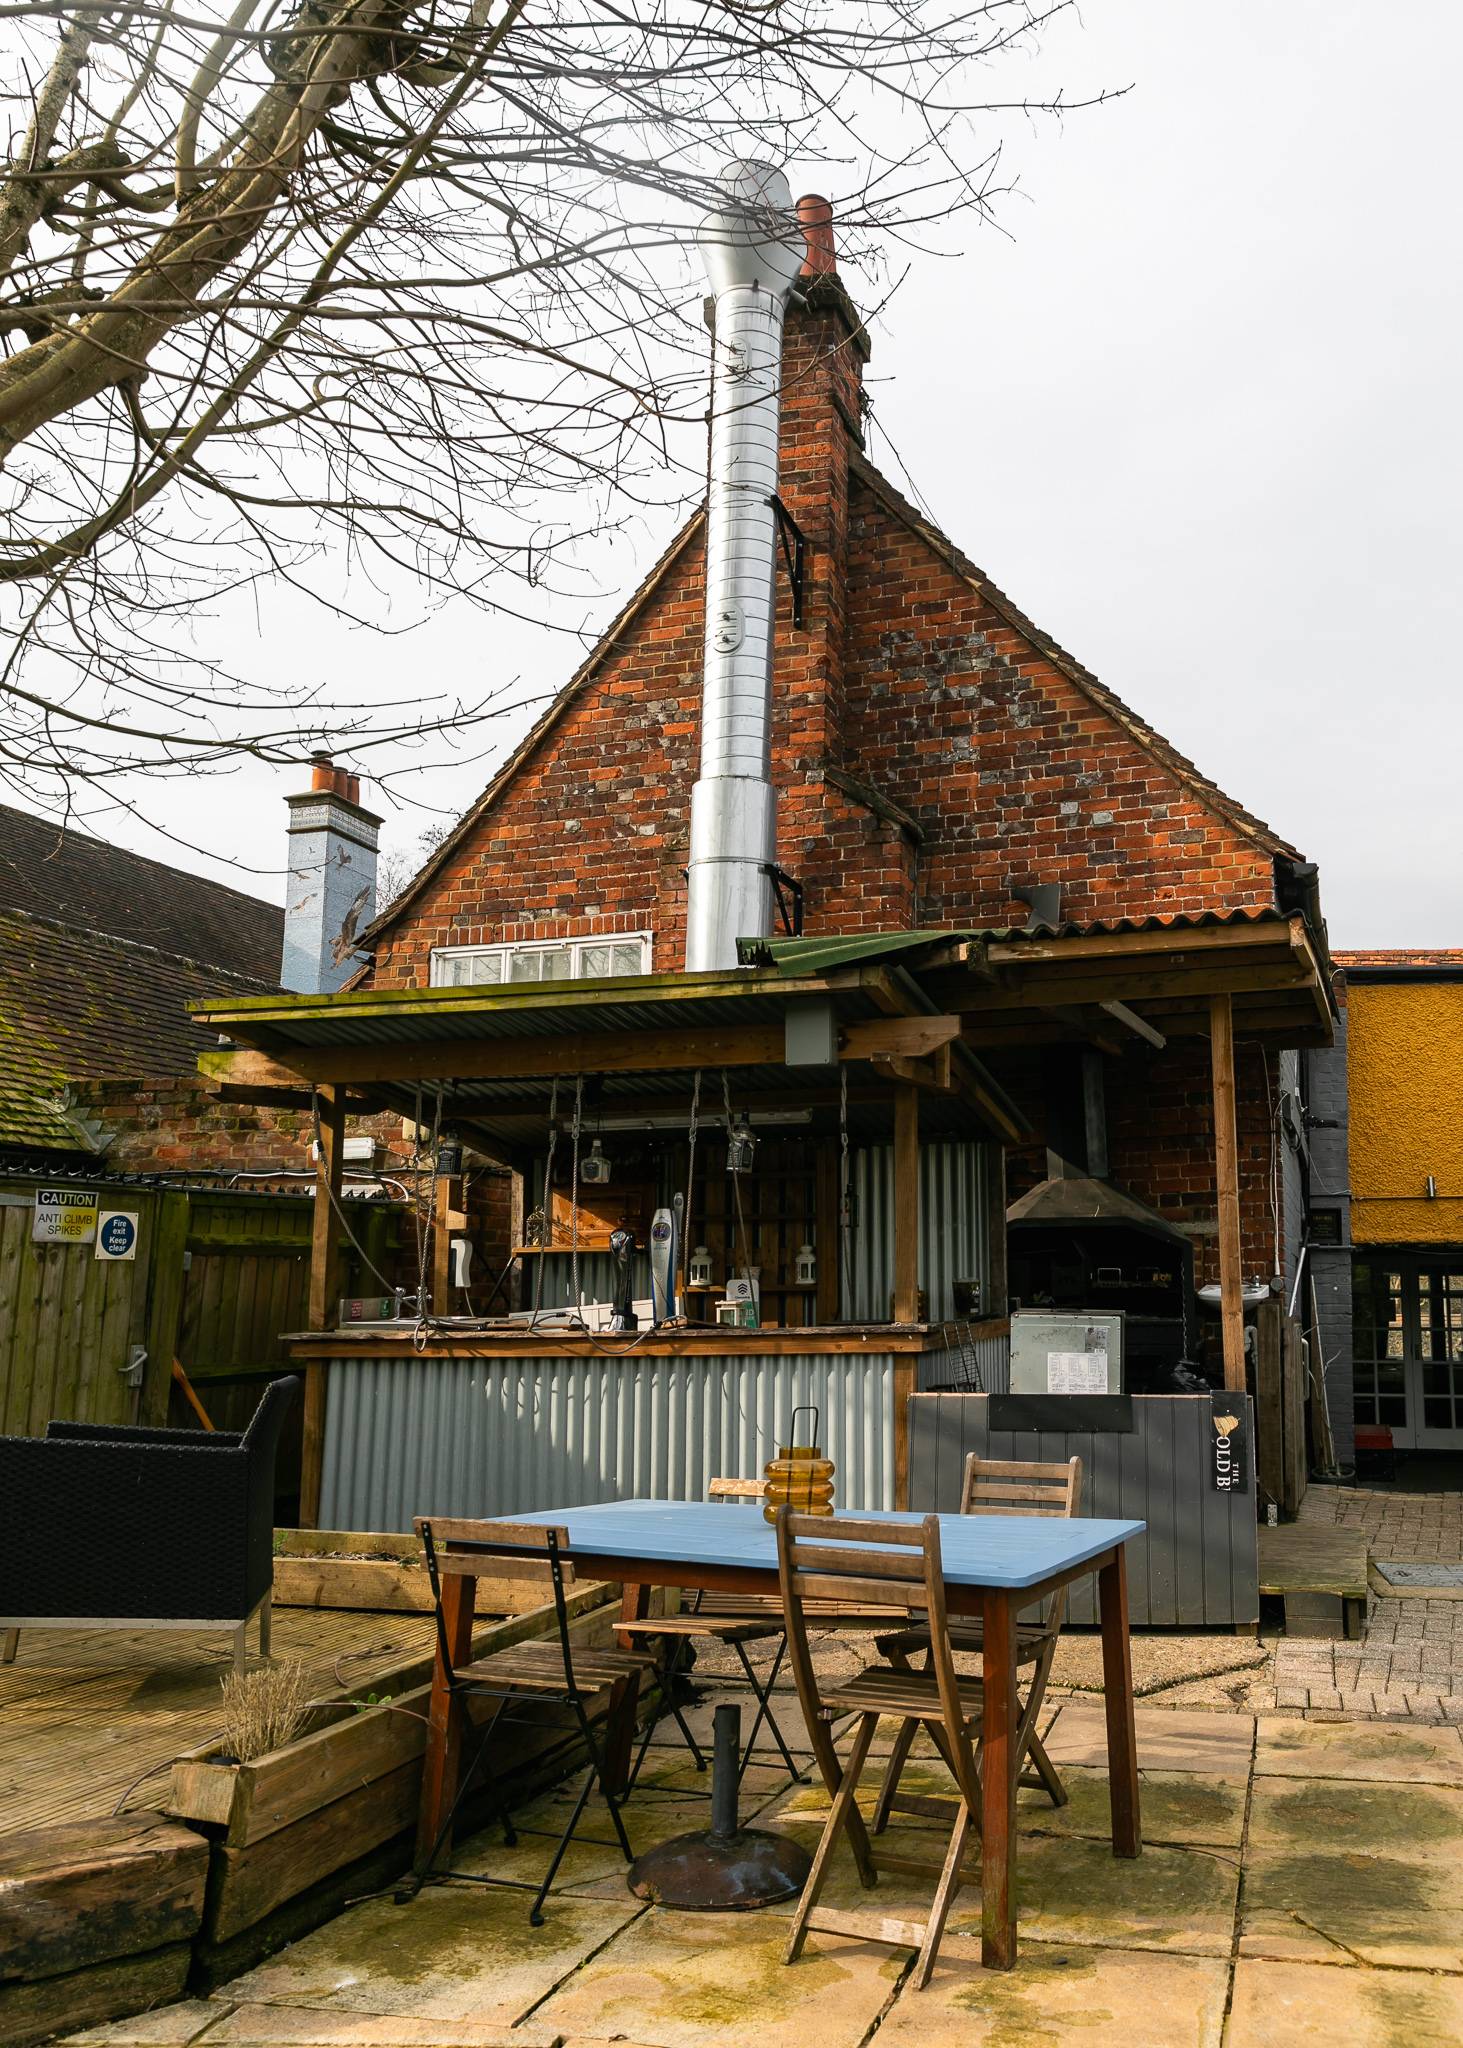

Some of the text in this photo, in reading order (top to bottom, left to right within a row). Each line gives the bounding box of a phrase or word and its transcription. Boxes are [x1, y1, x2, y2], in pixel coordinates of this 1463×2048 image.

[41, 1192, 93, 1206] CAUTION
[38, 1213, 93, 1225] ANTI CLIMB
[113, 1219, 127, 1228] Fire
[47, 1225, 81, 1235] SPIKES
[109, 1236, 127, 1246] Keep
[108, 1244, 126, 1252] clear
[1216, 1436, 1231, 1472] OLD
